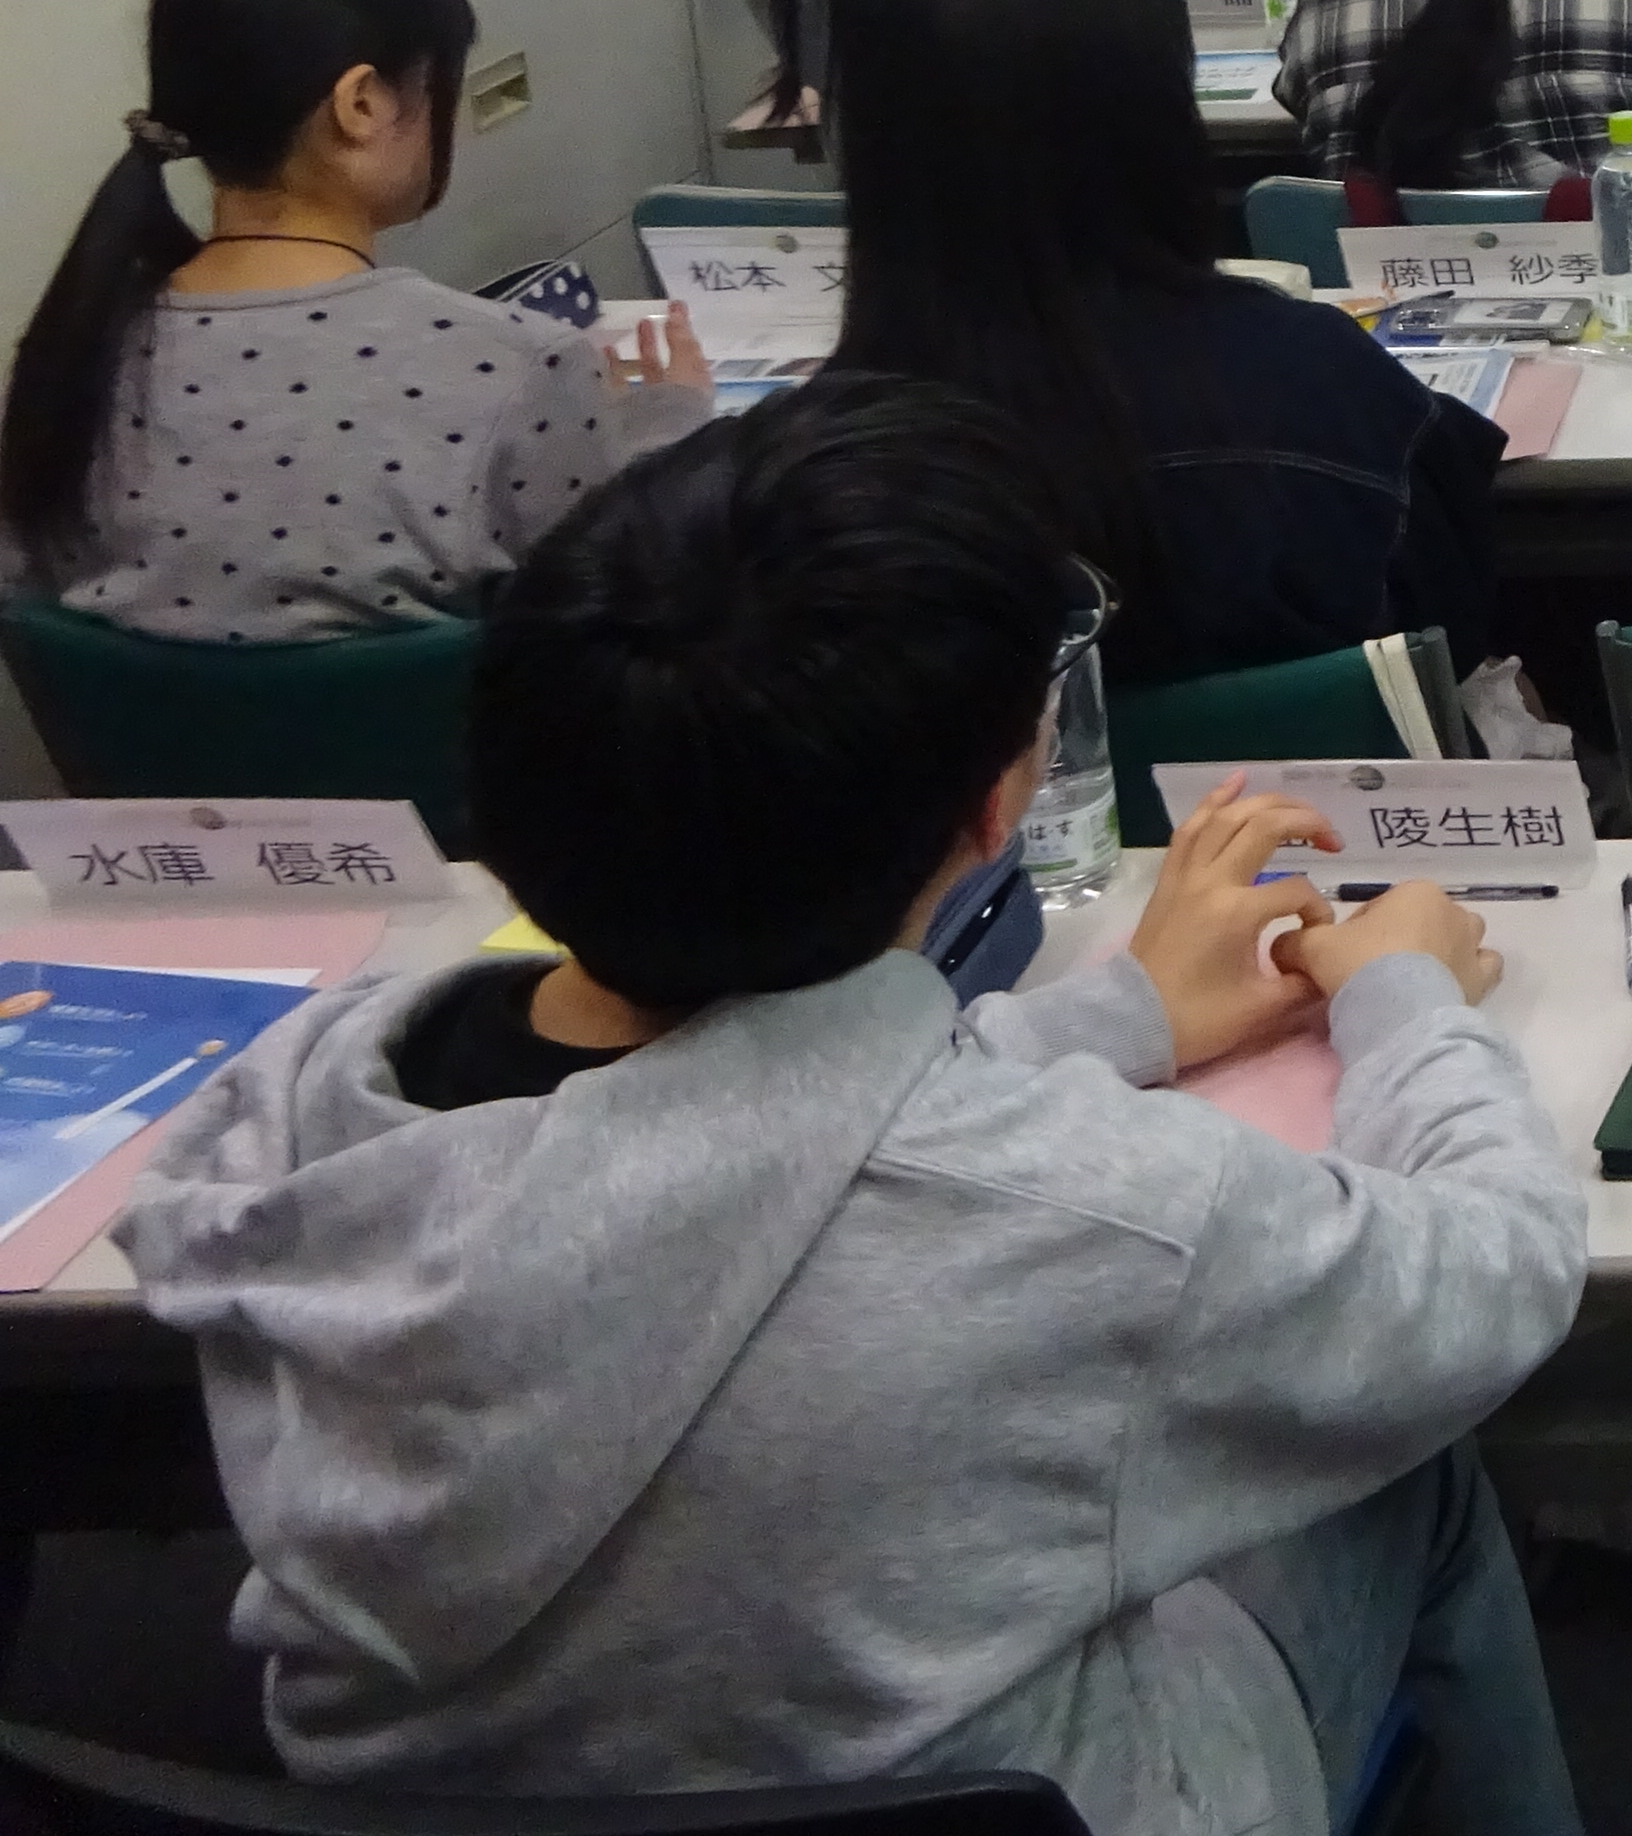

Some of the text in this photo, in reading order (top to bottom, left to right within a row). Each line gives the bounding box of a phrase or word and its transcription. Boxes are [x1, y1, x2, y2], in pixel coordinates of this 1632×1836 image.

[687, 259, 788, 295] 松本
[1379, 252, 1600, 289] 藤田 紗季
[1369, 805, 1566, 849] 陵生樹
[67, 841, 398, 886] 水庫 優希
